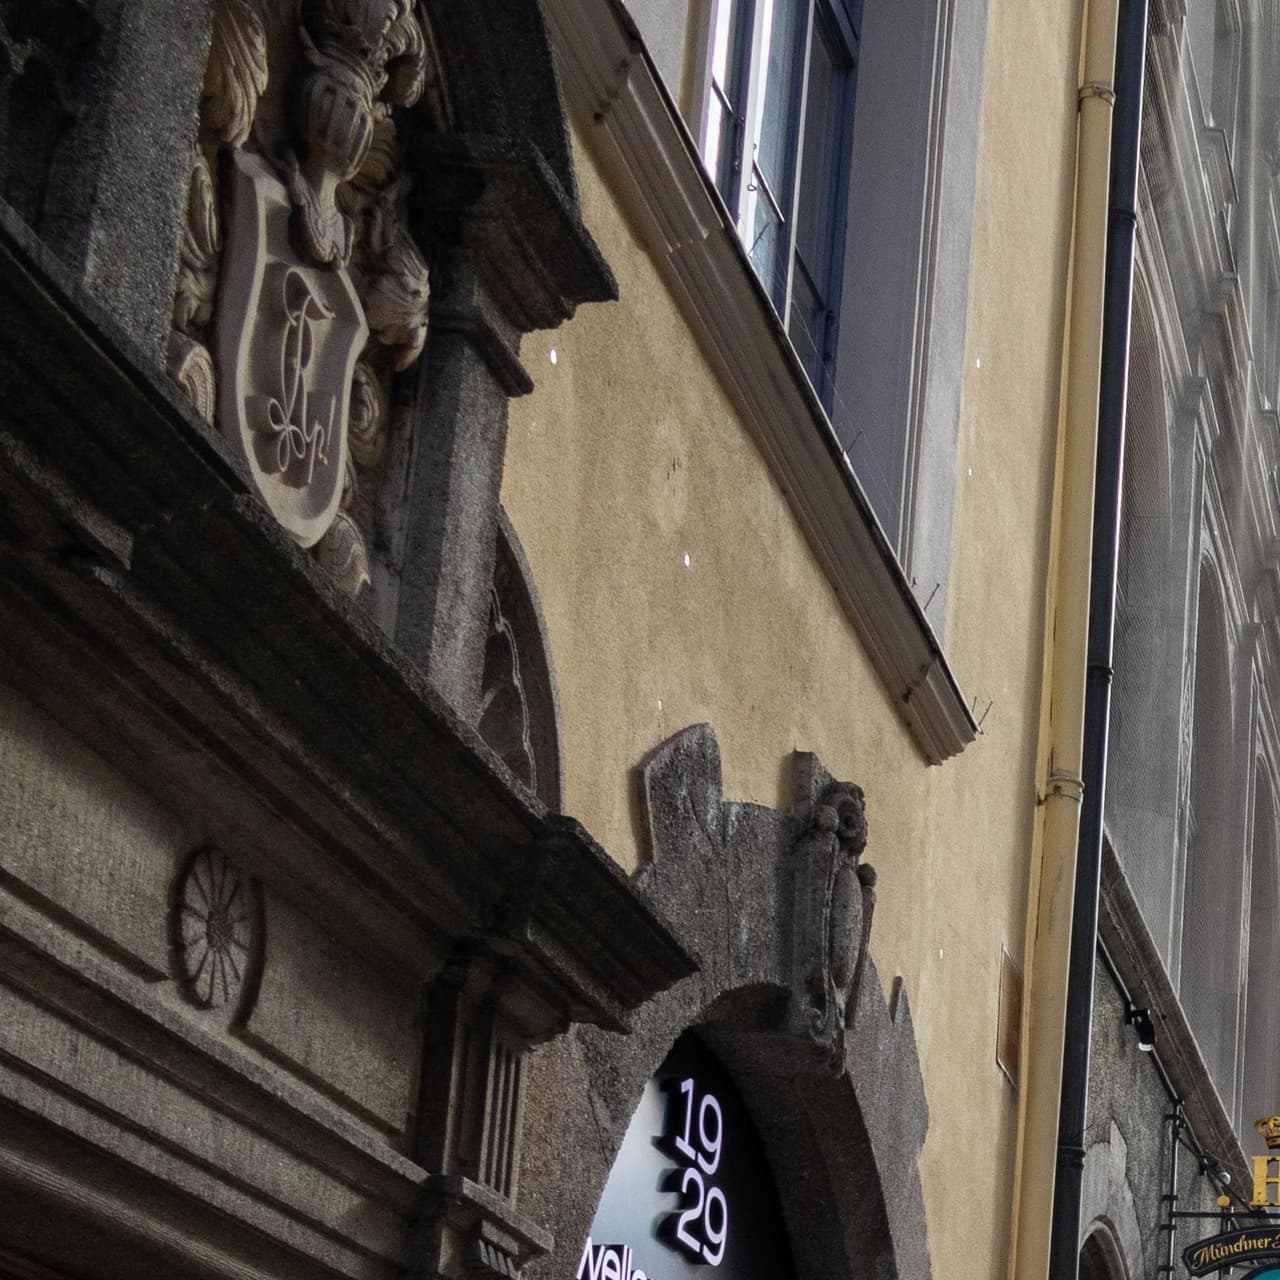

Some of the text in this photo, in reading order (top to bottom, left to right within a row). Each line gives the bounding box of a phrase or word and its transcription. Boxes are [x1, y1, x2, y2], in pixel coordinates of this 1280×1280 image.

[674, 1077, 723, 1175] 19
[675, 1167, 728, 1267] 29
[1190, 1235, 1272, 1271] Münchner
